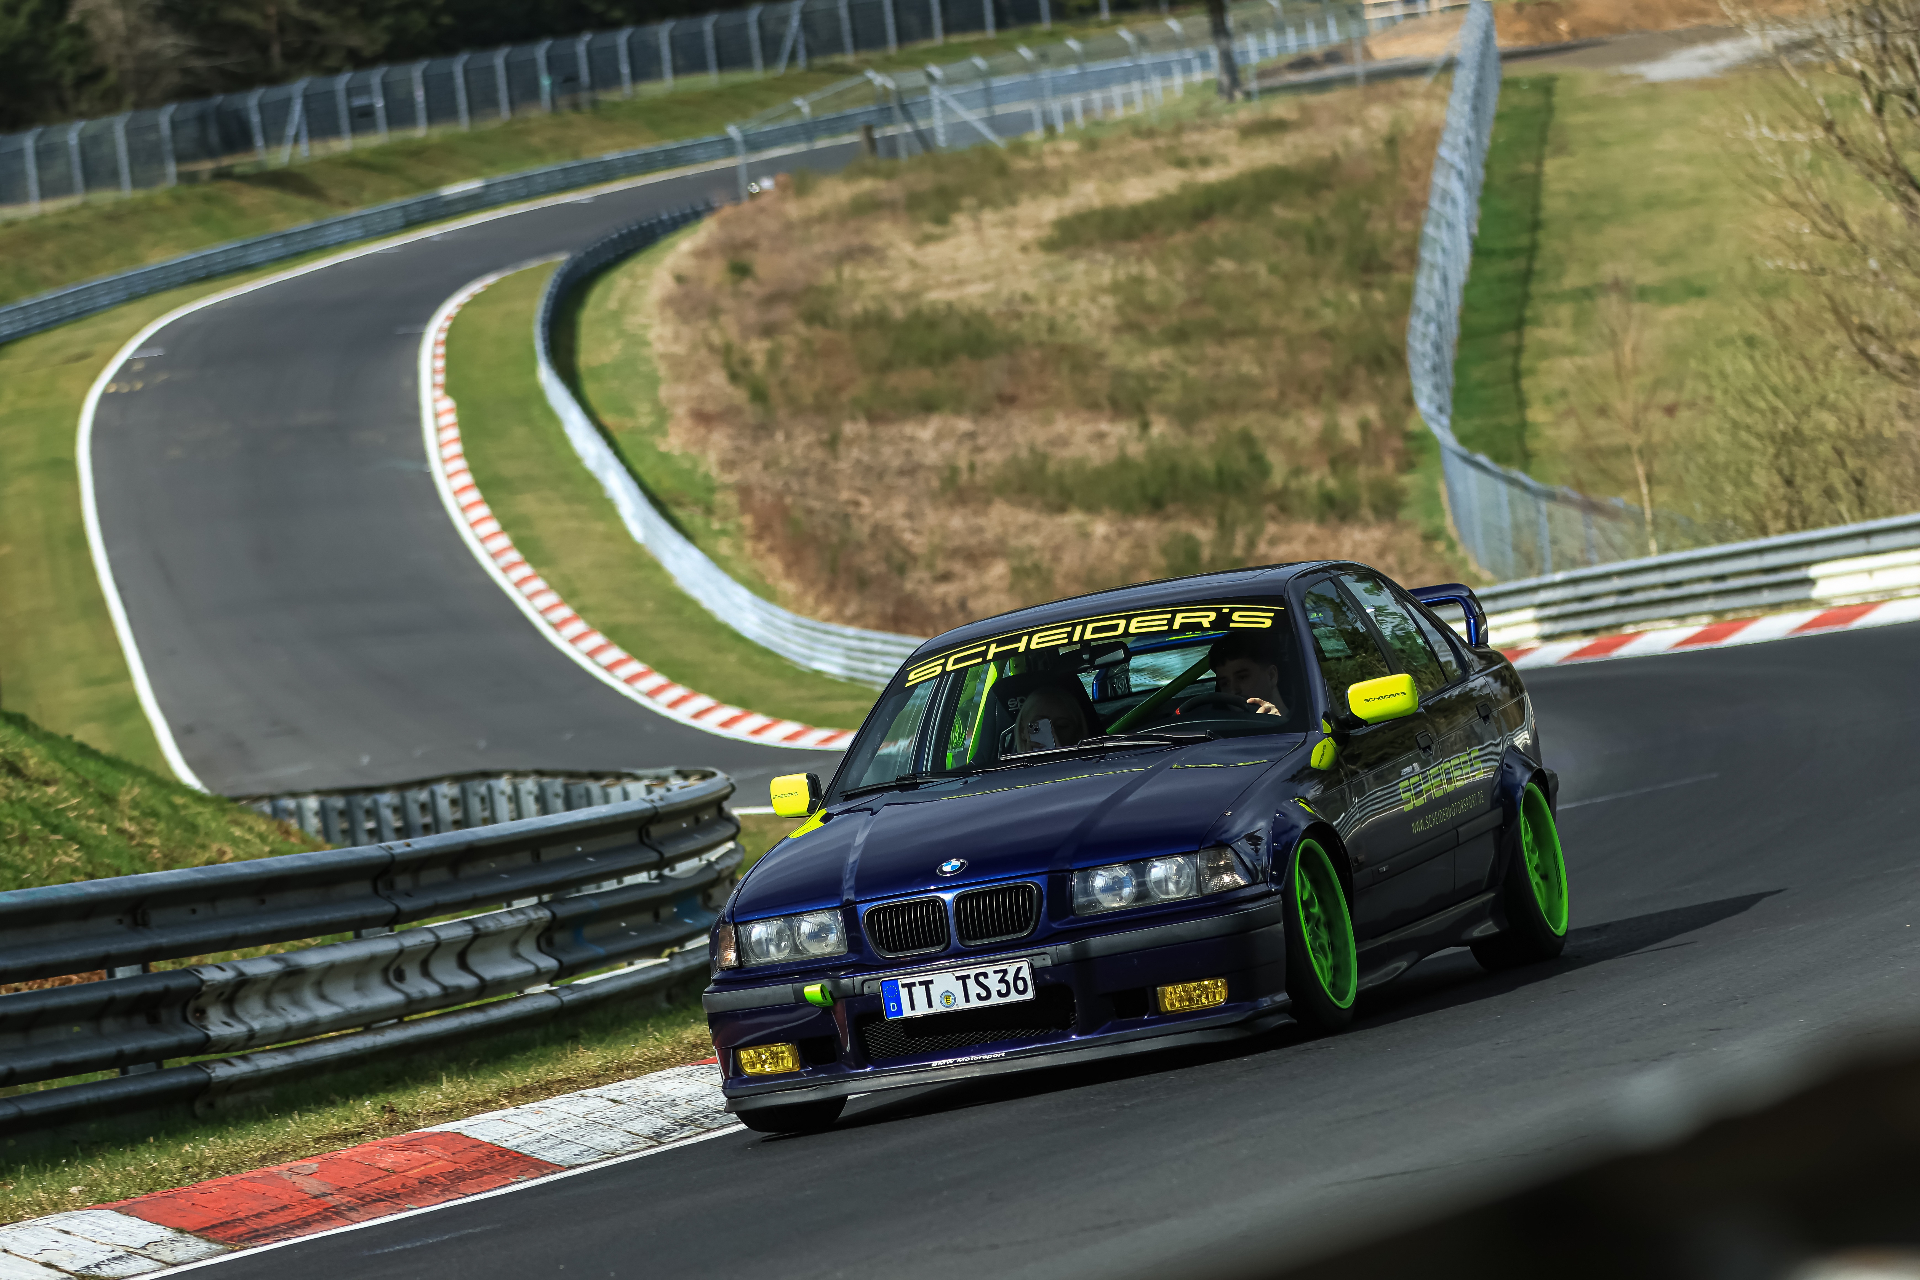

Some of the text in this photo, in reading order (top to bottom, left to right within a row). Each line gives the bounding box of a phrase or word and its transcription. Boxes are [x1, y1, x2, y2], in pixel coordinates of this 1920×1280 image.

[904, 607, 1275, 688] SCHEIDER'S
[889, 1002, 898, 1012] D
[901, 978, 935, 1011] TT
[955, 965, 1028, 1004] TS36
